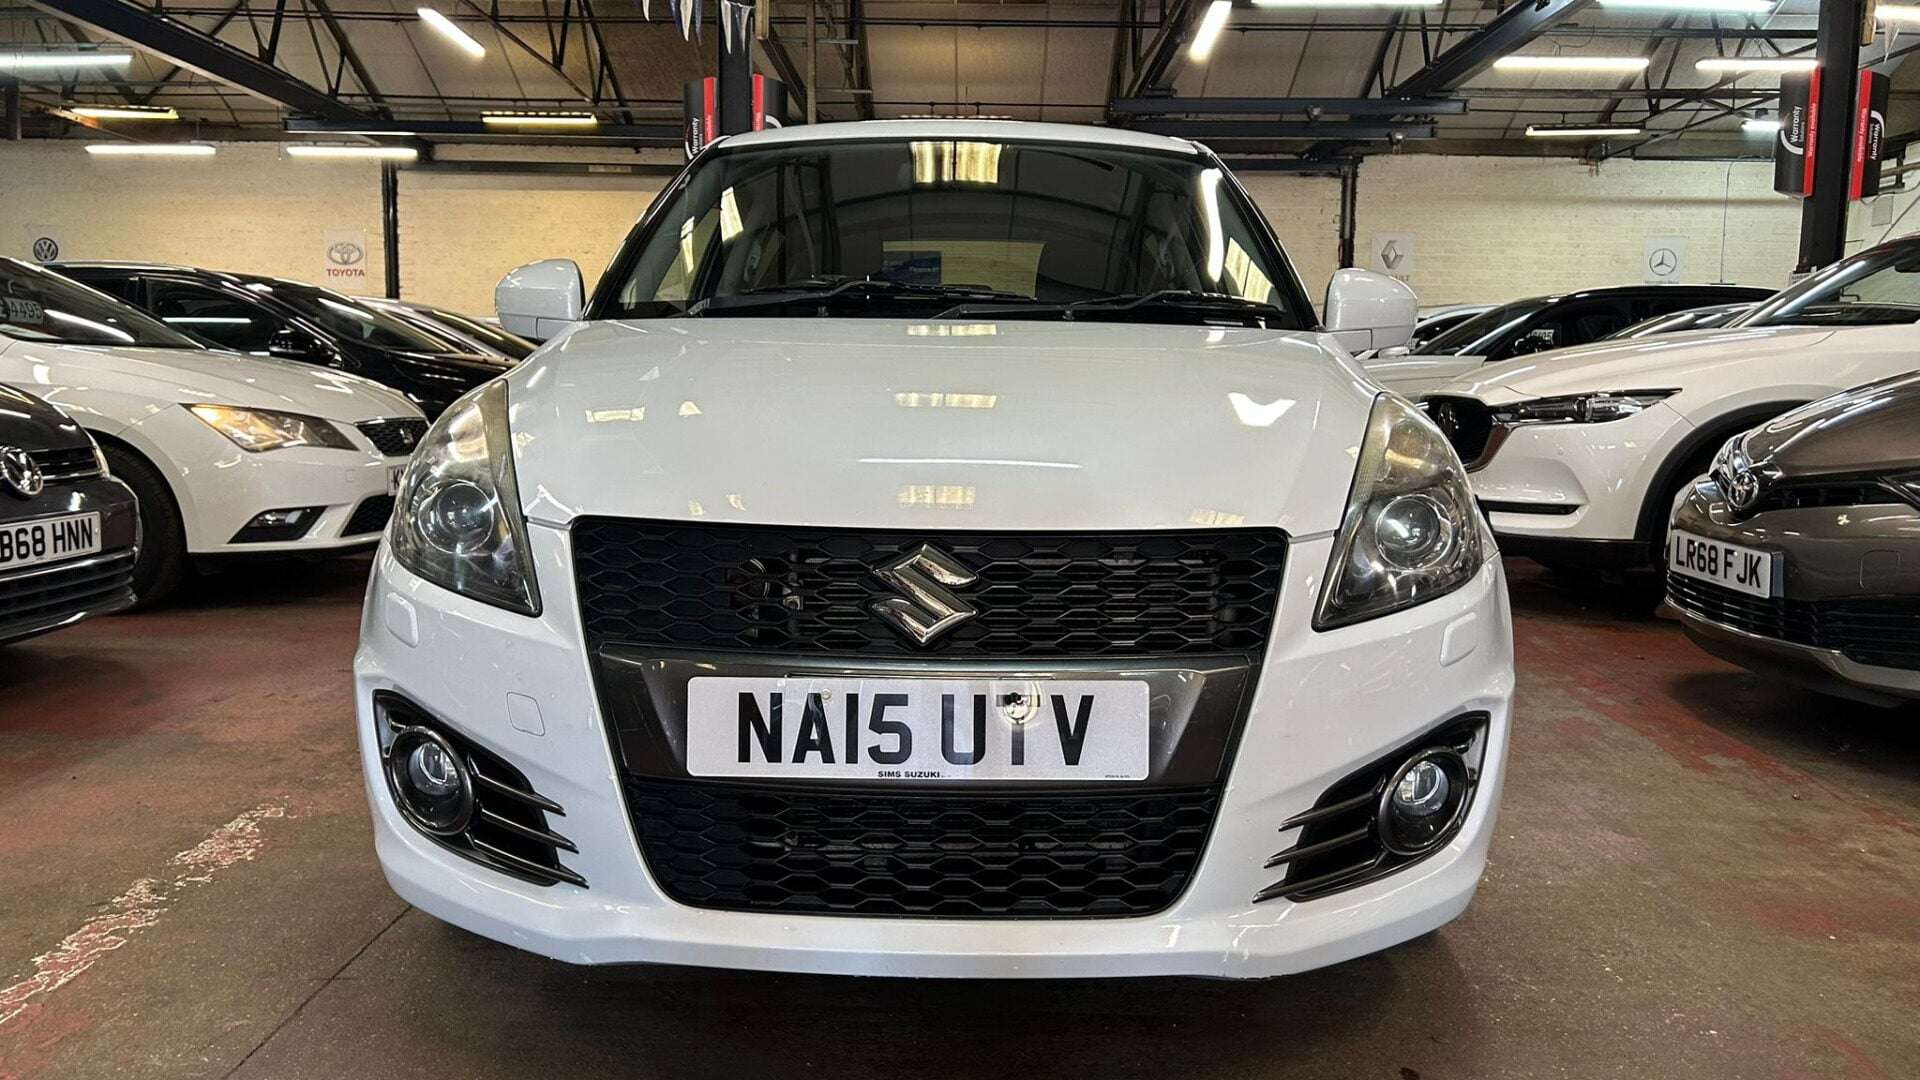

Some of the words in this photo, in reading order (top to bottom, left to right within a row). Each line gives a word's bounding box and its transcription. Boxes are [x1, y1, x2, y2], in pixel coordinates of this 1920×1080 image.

[692, 118, 700, 154] Warranty
[1790, 105, 1802, 143] Warranty
[1870, 123, 1881, 160] Warranty
[326, 268, 365, 277] TOYOTA
[51, 518, 93, 554] HNN
[1675, 536, 1719, 576] LR68
[1723, 547, 1762, 589] FJK
[737, 691, 914, 765] NA15
[940, 693, 1095, 766] UTV
